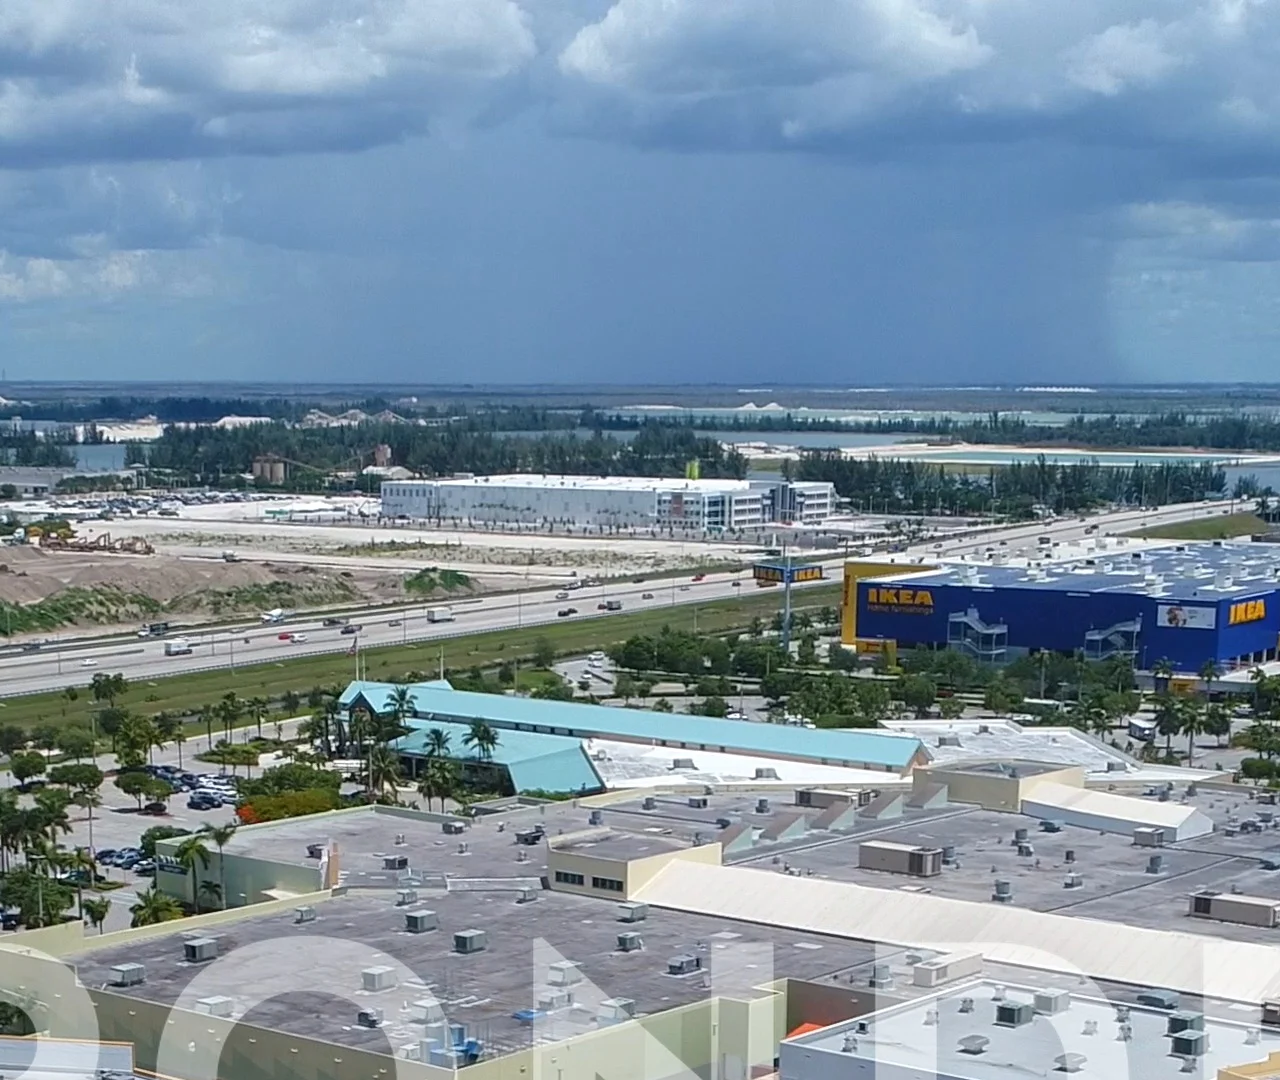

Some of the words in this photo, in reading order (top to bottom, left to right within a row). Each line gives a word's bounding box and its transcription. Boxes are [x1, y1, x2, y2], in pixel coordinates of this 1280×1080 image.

[754, 565, 782, 580] IKEA
[795, 568, 821, 580] IKEA
[868, 588, 934, 606] IKEA
[1229, 599, 1266, 625] IKEA
